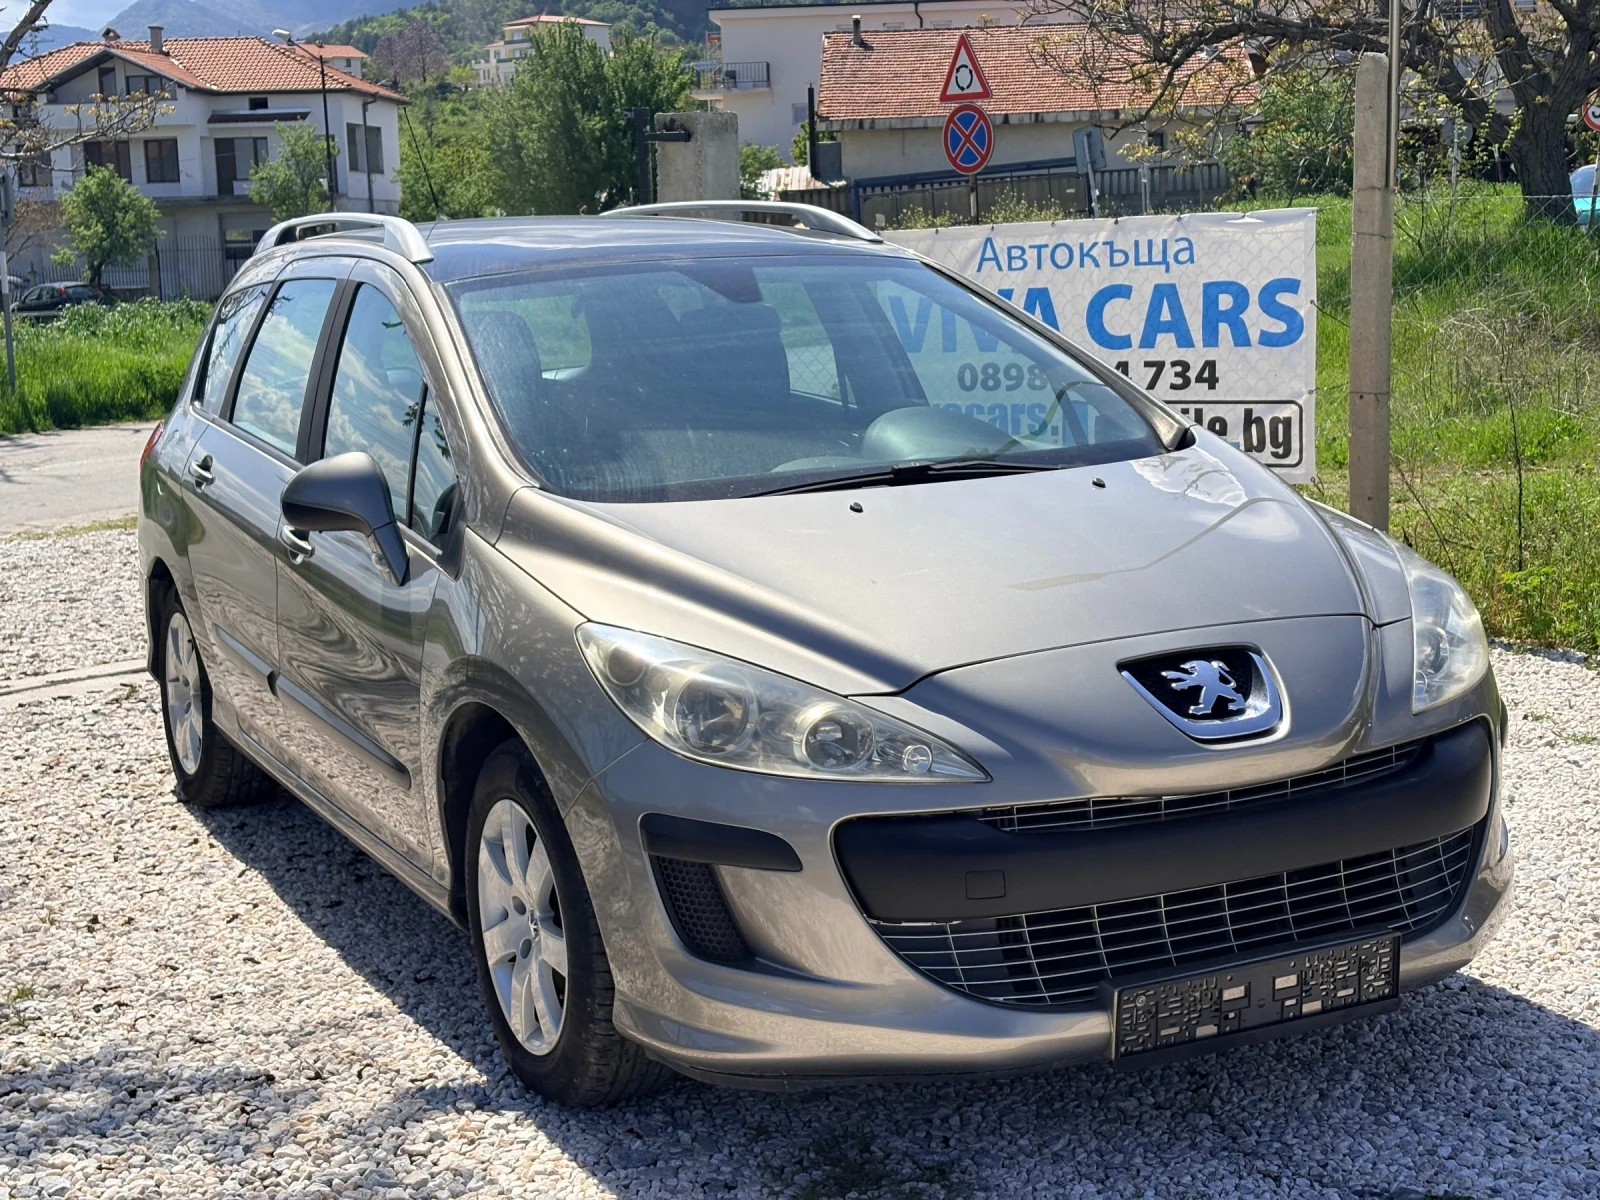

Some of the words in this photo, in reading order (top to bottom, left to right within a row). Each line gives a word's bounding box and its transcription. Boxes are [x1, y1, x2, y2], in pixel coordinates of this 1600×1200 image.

[976, 236, 1195, 274] Автокъща
[1085, 277, 1305, 351] CARS
[957, 361, 1050, 392] 0898
[1143, 359, 1219, 391] 734
